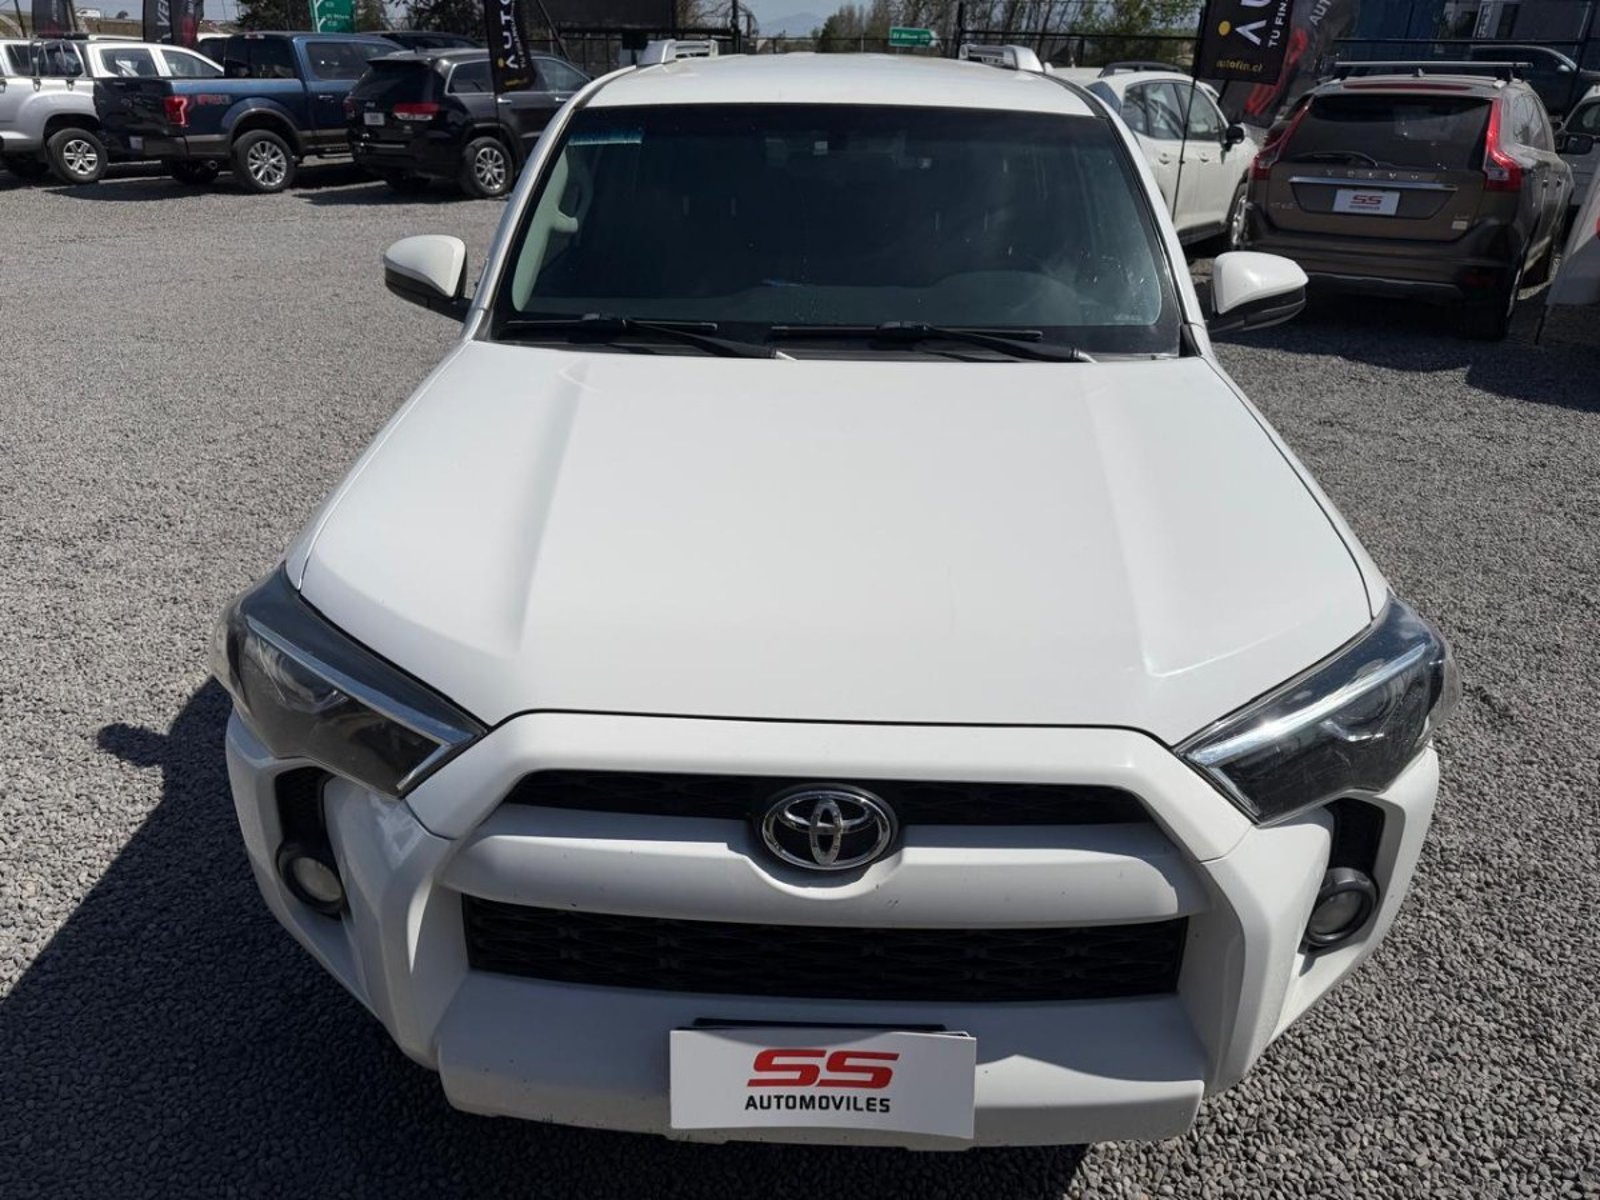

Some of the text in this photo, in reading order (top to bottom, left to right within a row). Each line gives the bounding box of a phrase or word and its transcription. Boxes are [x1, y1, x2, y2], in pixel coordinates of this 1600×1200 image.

[1267, 0, 1289, 48] TU FIN
[748, 1049, 899, 1089] SS
[744, 1094, 891, 1114] AUTOMOVILES
